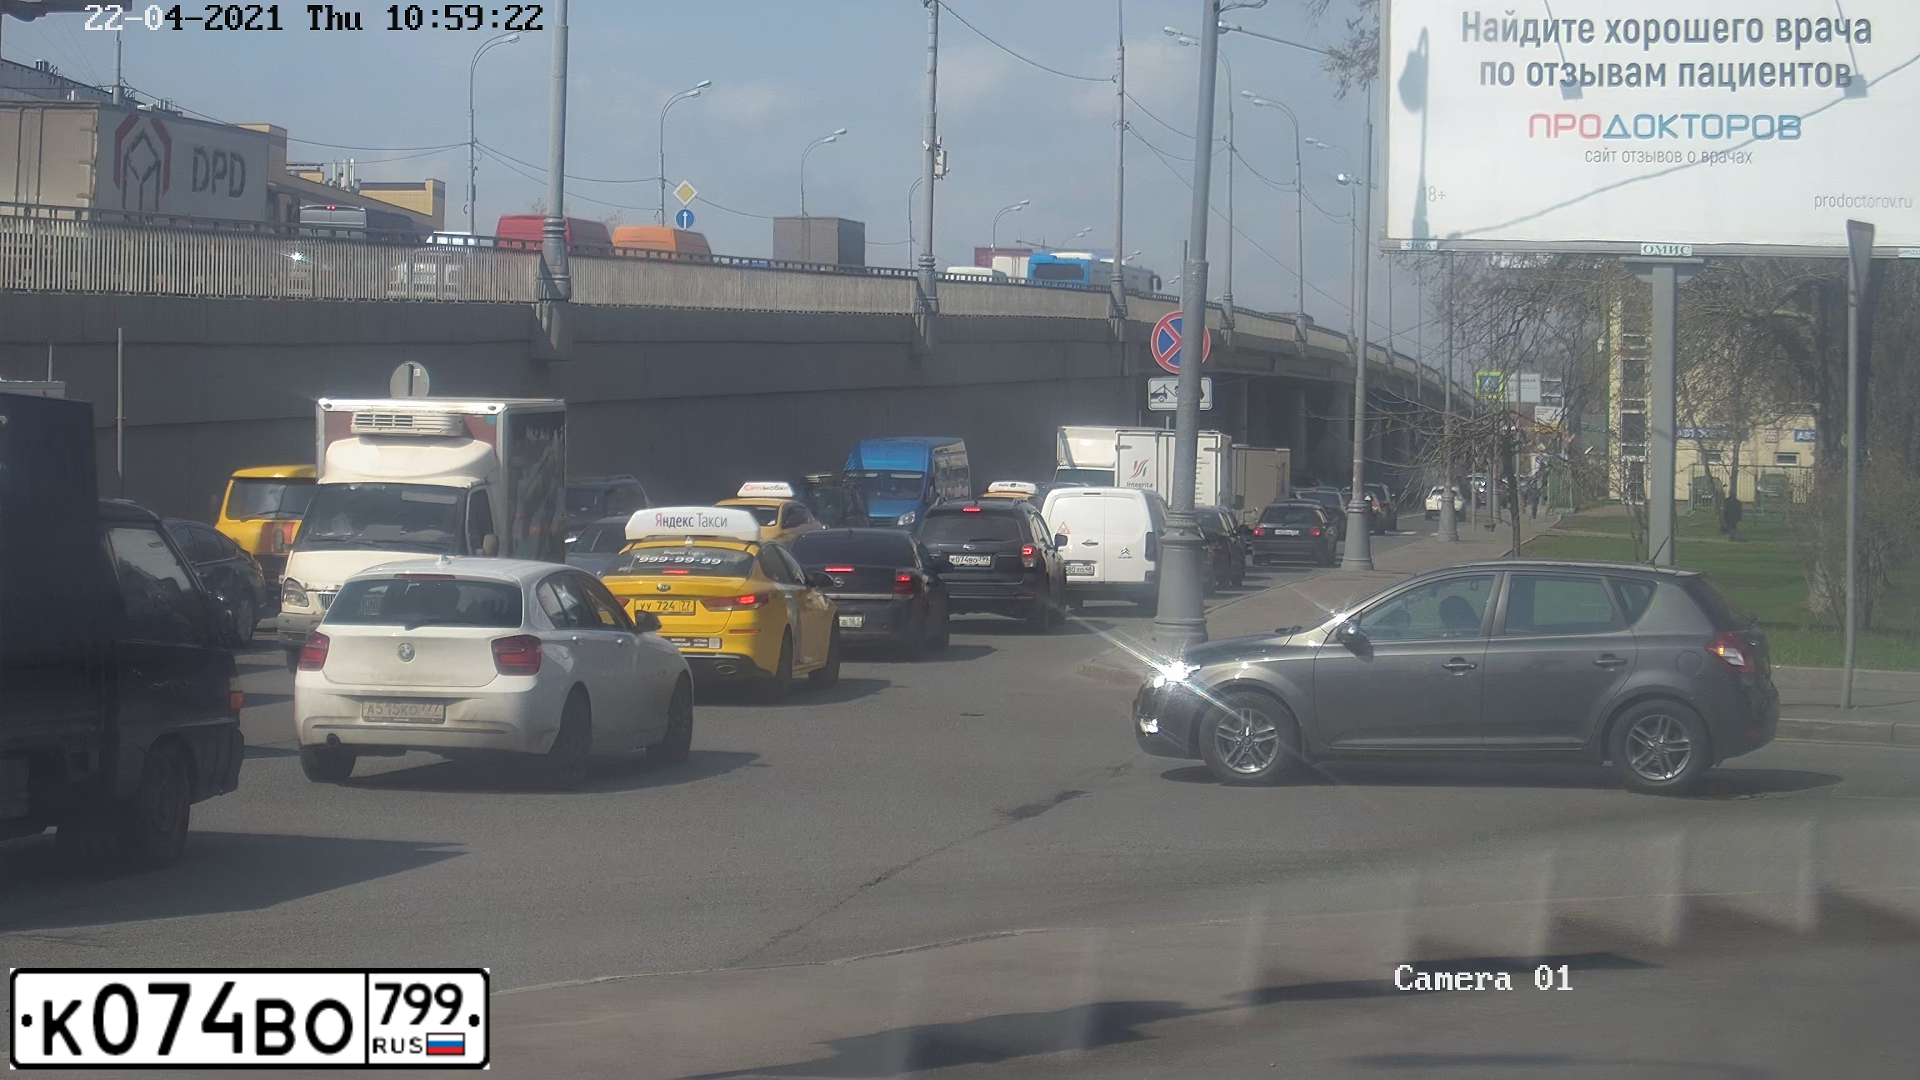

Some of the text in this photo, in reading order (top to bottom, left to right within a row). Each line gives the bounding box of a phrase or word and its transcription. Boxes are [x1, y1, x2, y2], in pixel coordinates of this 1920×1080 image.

[1461, 10, 1872, 51] Найдите хорошего врача
[1480, 61, 1851, 92] по отзывам пациентов
[1529, 113, 1801, 140] ПРОДОКТОРОВ
[1585, 147, 1753, 167] сайт отзывов о врачах
[191, 146, 247, 199] DPD
[1814, 193, 1914, 210] prodoctorov.ru
[1643, 244, 1691, 256] ОМИС
[655, 512, 728, 529] Яндекс Такси
